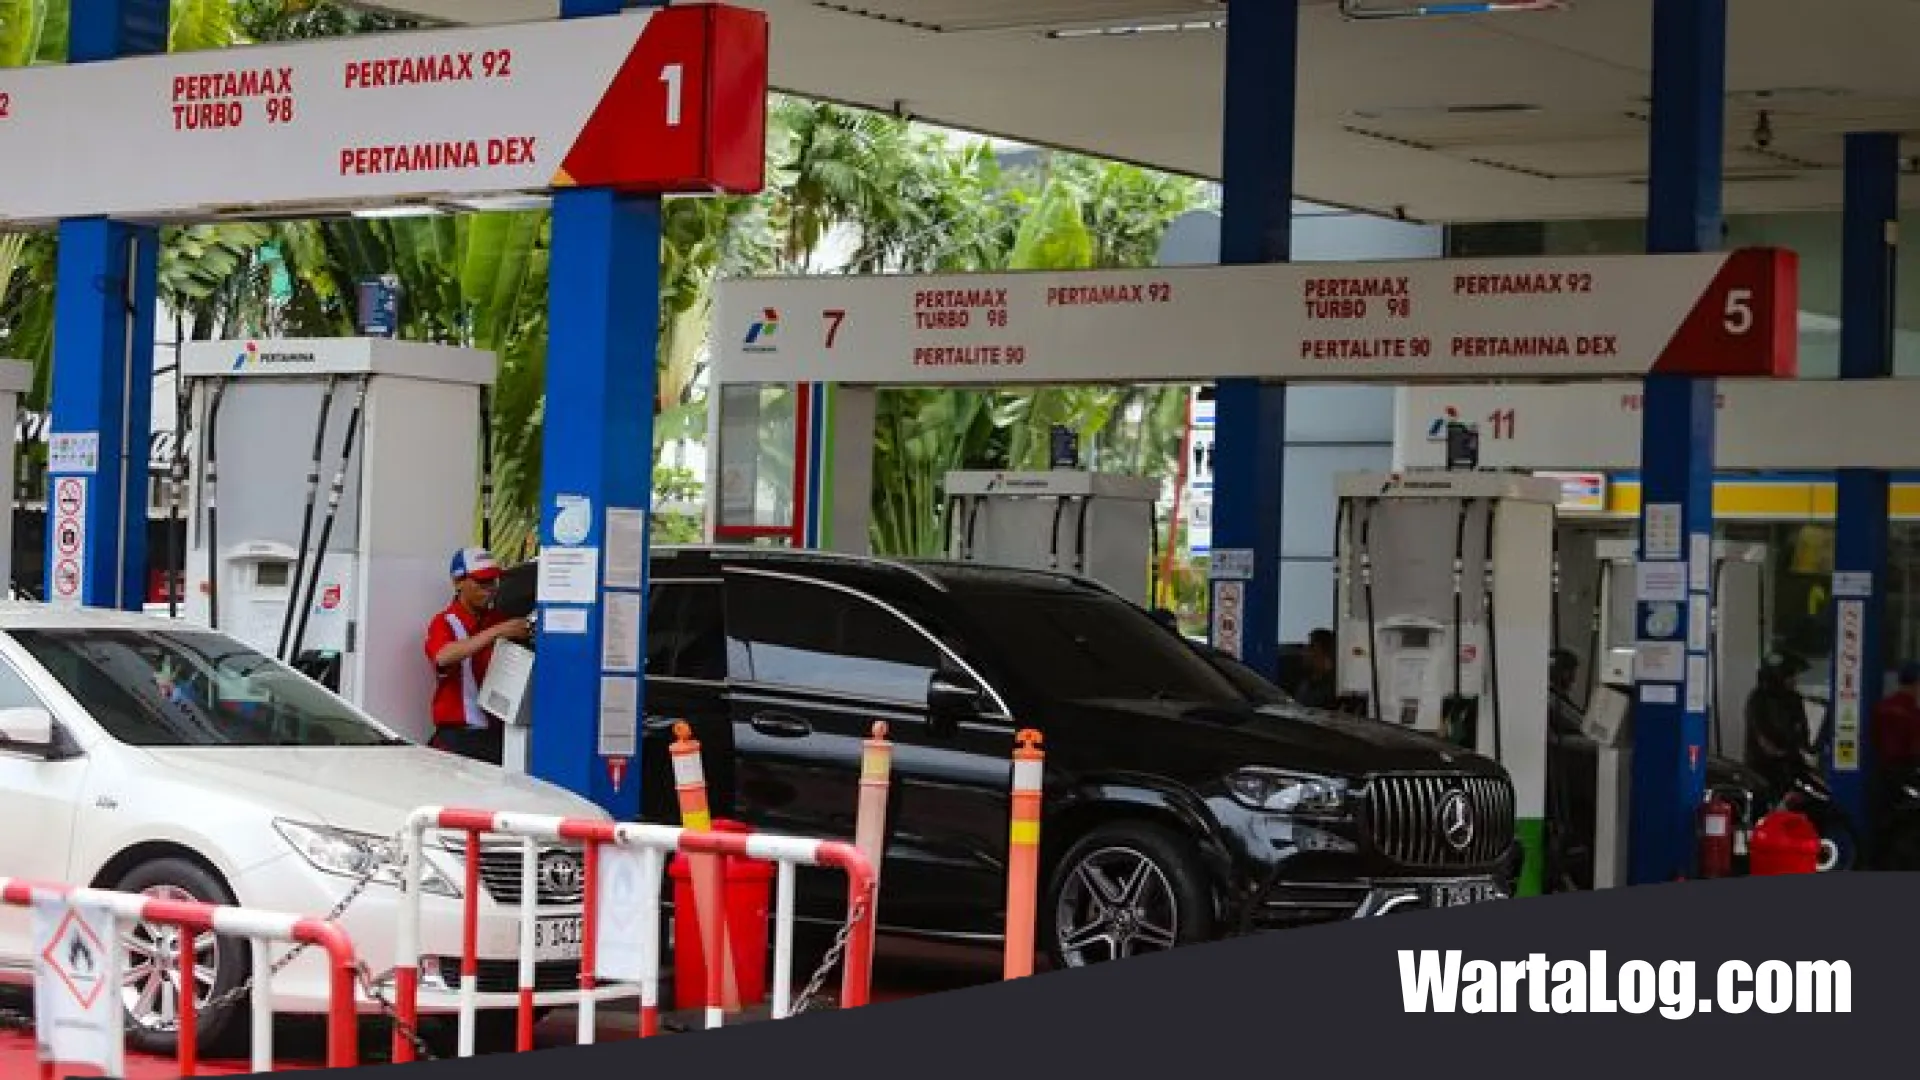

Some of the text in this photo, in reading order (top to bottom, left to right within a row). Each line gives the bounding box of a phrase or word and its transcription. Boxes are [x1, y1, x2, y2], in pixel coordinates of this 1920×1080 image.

[345, 49, 511, 88] PERTAMAX 92
[172, 67, 294, 101] PERTAMAX
[658, 63, 683, 126] 1
[172, 96, 292, 130] TURBO 98
[340, 137, 535, 175] PERTAMINA DEX
[1047, 283, 1171, 305] PERTAMAX 92
[1304, 277, 1408, 297] PERTAMAX
[1454, 273, 1592, 294] PERTAMAX 92
[914, 288, 1007, 308] PERTAMAX
[1305, 298, 1410, 318] TURBO 98
[915, 309, 1007, 329] TURBO 98
[1724, 289, 1753, 333] 5
[823, 310, 845, 348] 7
[914, 347, 1024, 365] PERTALITE 90
[1301, 338, 1431, 359] PERTALITE 90
[1452, 335, 1617, 357] PERTAMINA DEX
[1488, 408, 1515, 440] 11
